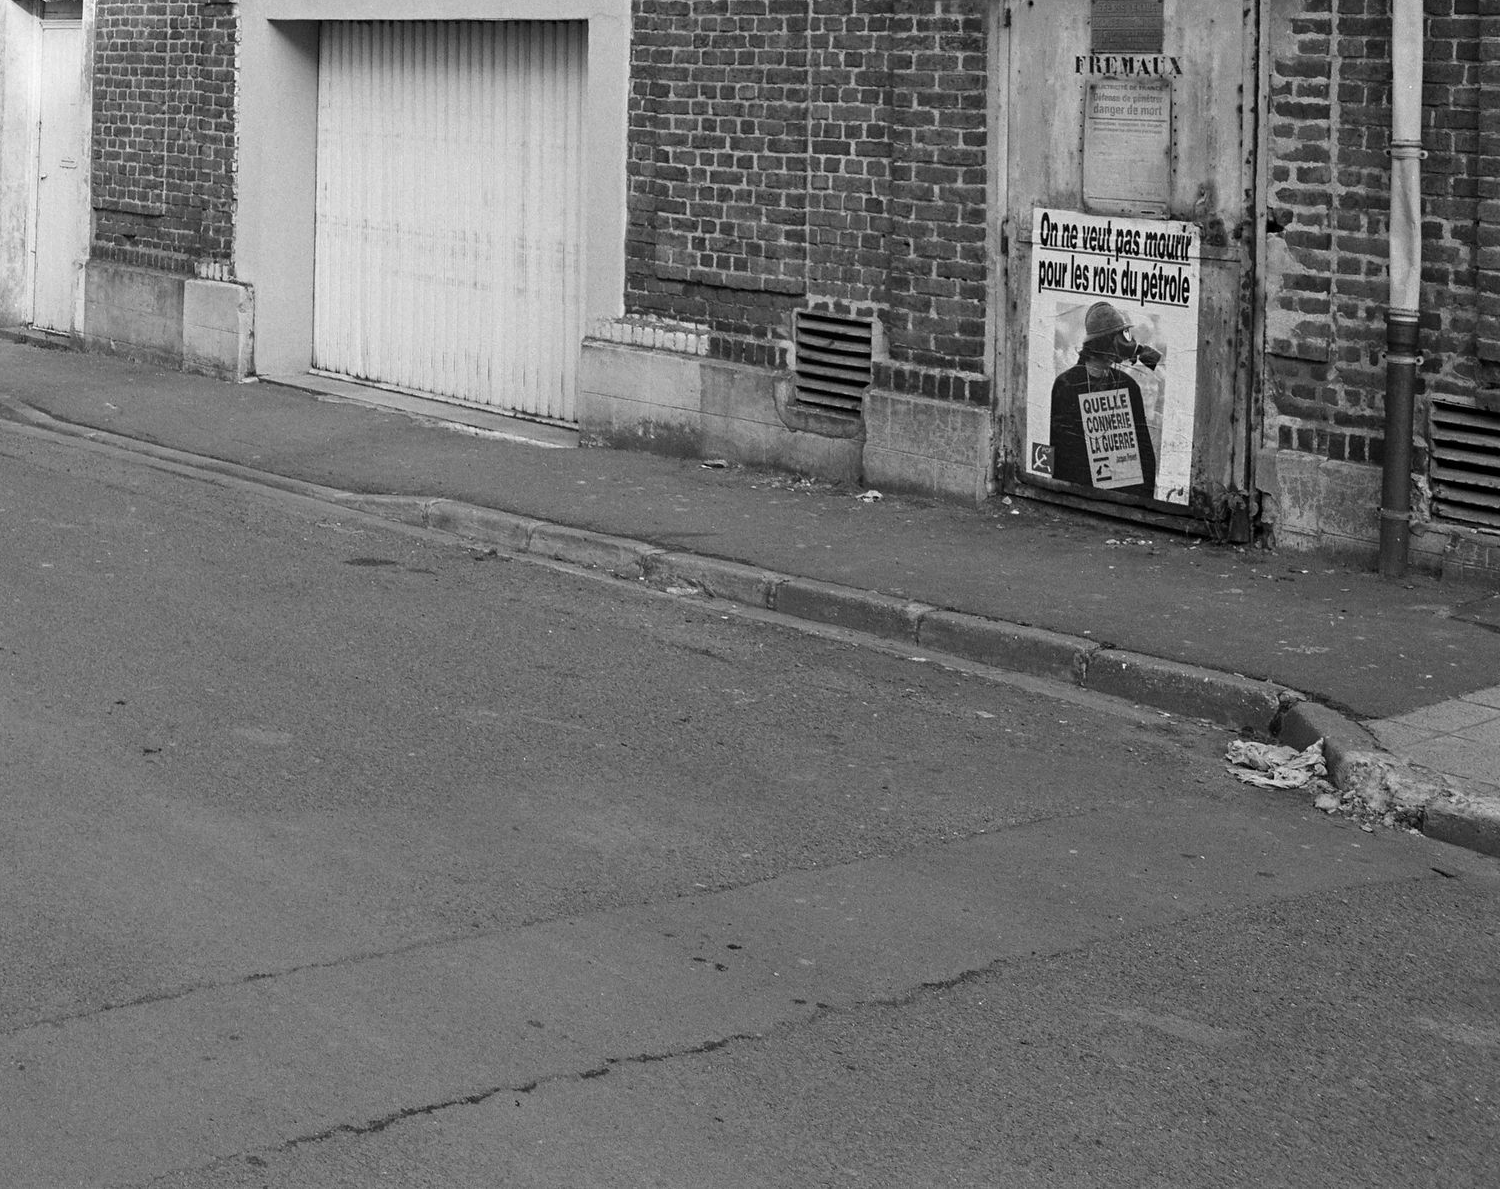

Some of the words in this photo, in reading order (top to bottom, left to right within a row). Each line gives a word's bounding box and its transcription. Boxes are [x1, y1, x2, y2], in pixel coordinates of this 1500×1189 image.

[1075, 55, 1182, 76] FREMAUX
[1093, 92, 1121, 102] Défense
[1122, 94, 1131, 102] de
[1132, 94, 1164, 104] pénétrer
[1093, 103, 1125, 117] danger
[1127, 104, 1138, 115] de
[1140, 106, 1162, 116] mort
[1040, 211, 1058, 247] On
[1061, 223, 1078, 249] ne
[1082, 220, 1112, 253] veut
[1115, 228, 1141, 262] pas
[1144, 225, 1192, 261] mourir
[1038, 260, 1067, 293] pour
[1070, 254, 1089, 291] les
[1093, 257, 1117, 294] rois
[1121, 260, 1138, 297] du
[1141, 263, 1190, 306] pétrole
[1083, 393, 1128, 414] QUELLE
[1086, 411, 1132, 433] CONNERIE
[1089, 436, 1102, 454] LA
[1102, 431, 1135, 452] GUERRE
